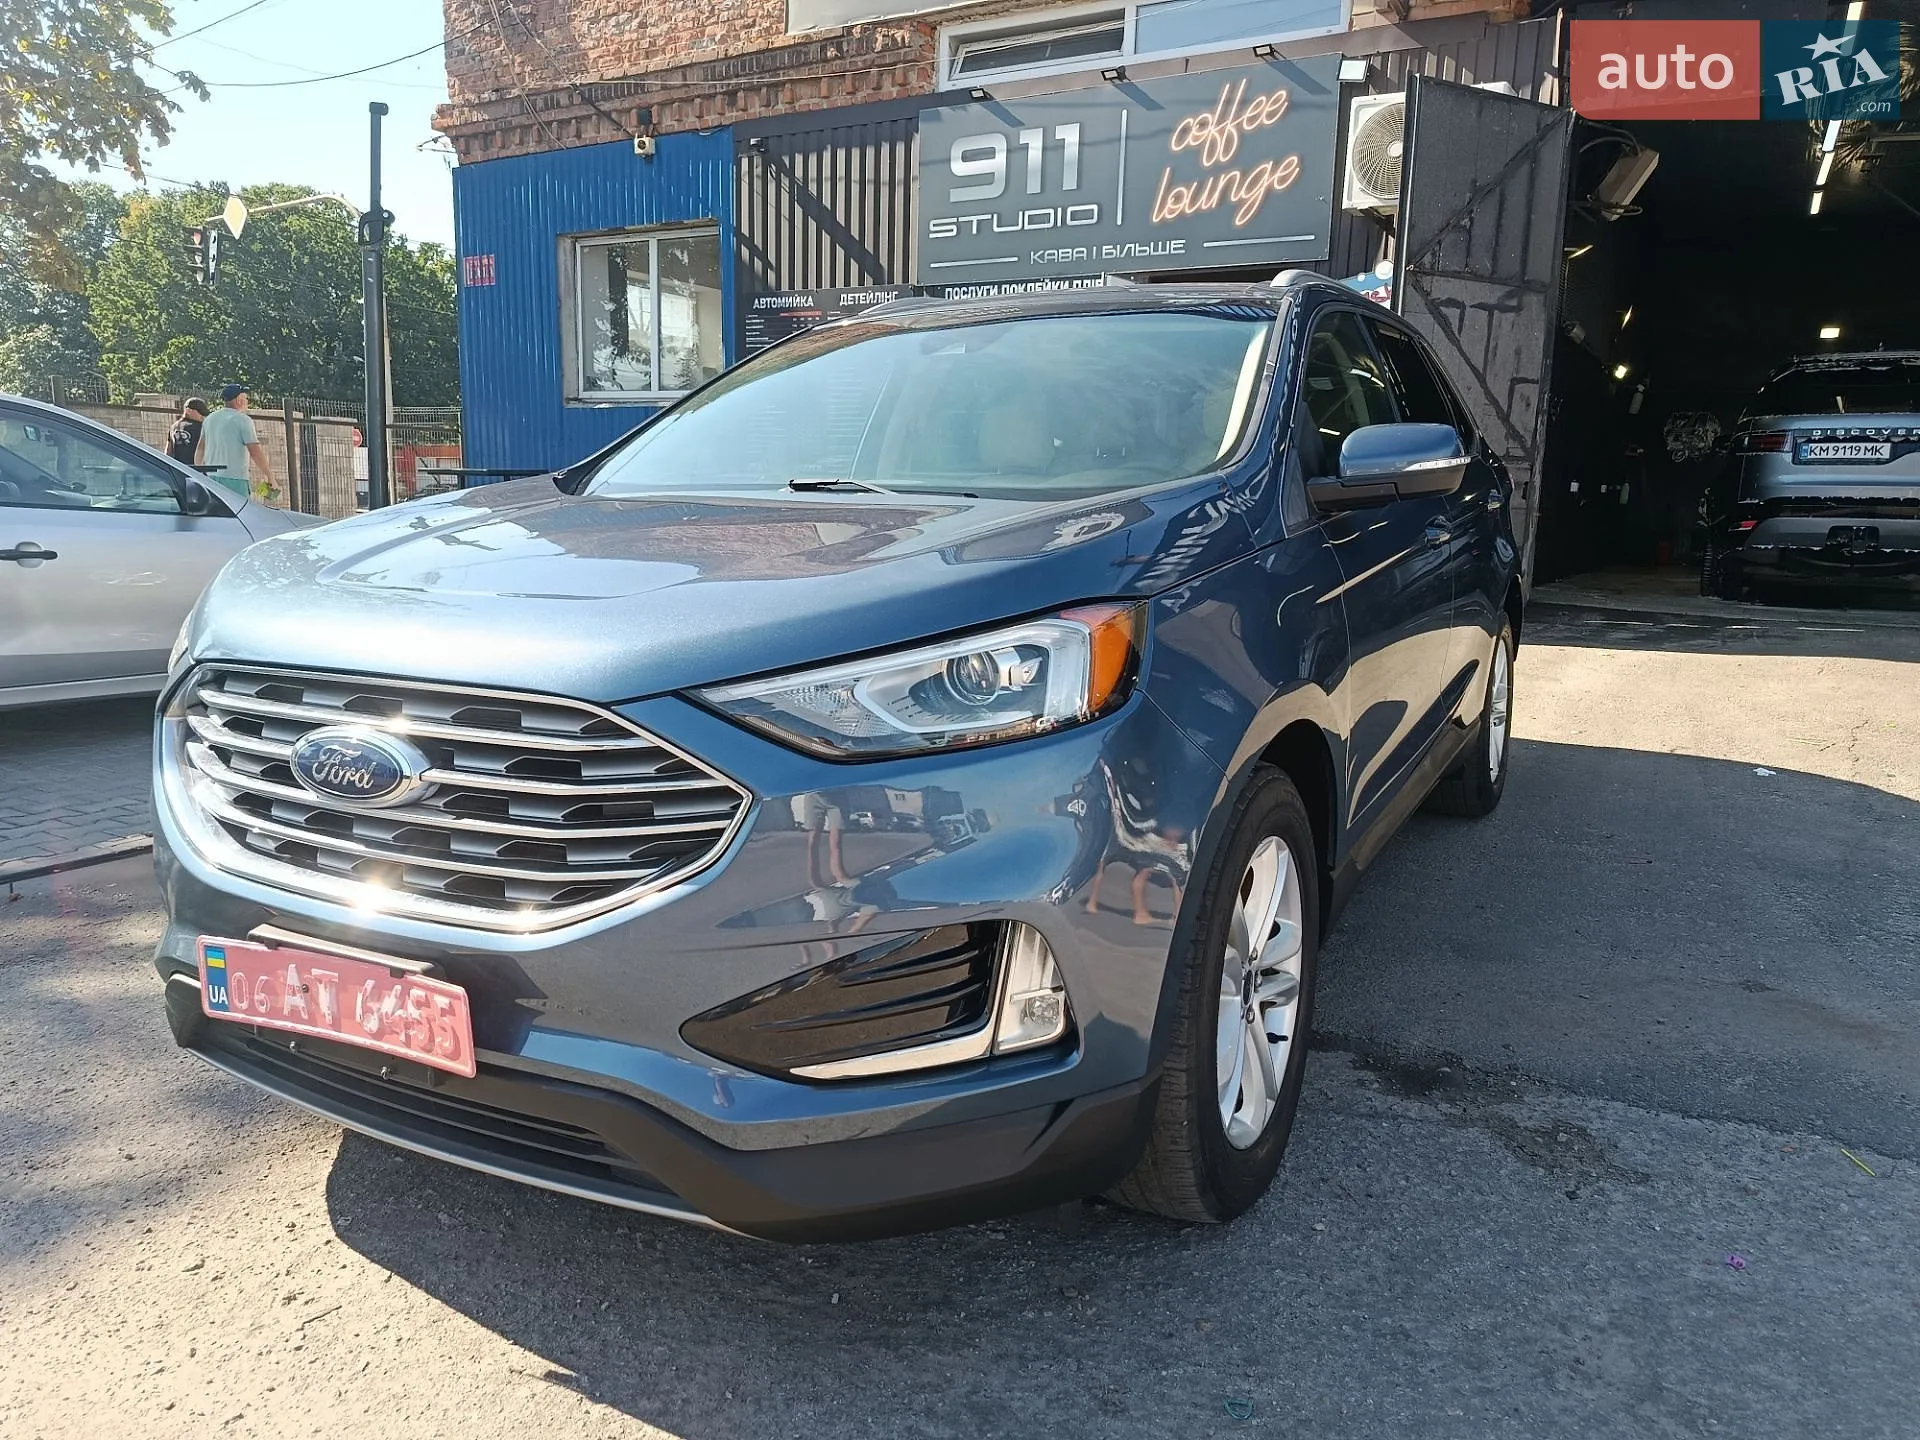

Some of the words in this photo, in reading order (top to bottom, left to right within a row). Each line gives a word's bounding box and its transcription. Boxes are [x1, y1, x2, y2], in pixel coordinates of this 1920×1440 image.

[1171, 77, 1289, 168] coffee
[950, 122, 1081, 203] 911
[1152, 155, 1300, 226] lounge
[929, 203, 1099, 239] STUDIO
[1030, 247, 1087, 265] КАВА
[1102, 239, 1186, 259] БІЛЬШЕ
[752, 294, 814, 309] АВТОМИЙКА
[839, 290, 899, 306] ДЕТЕЙЛІНГ
[945, 285, 999, 301] ПОСЛУГИ
[1809, 445, 1830, 457] KM
[1832, 445, 1862, 457] 9119
[1863, 445, 1885, 457] MK
[312, 744, 377, 789] Ford
[208, 983, 229, 1005] UA
[231, 971, 271, 1014] 06
[283, 963, 339, 1025] AT
